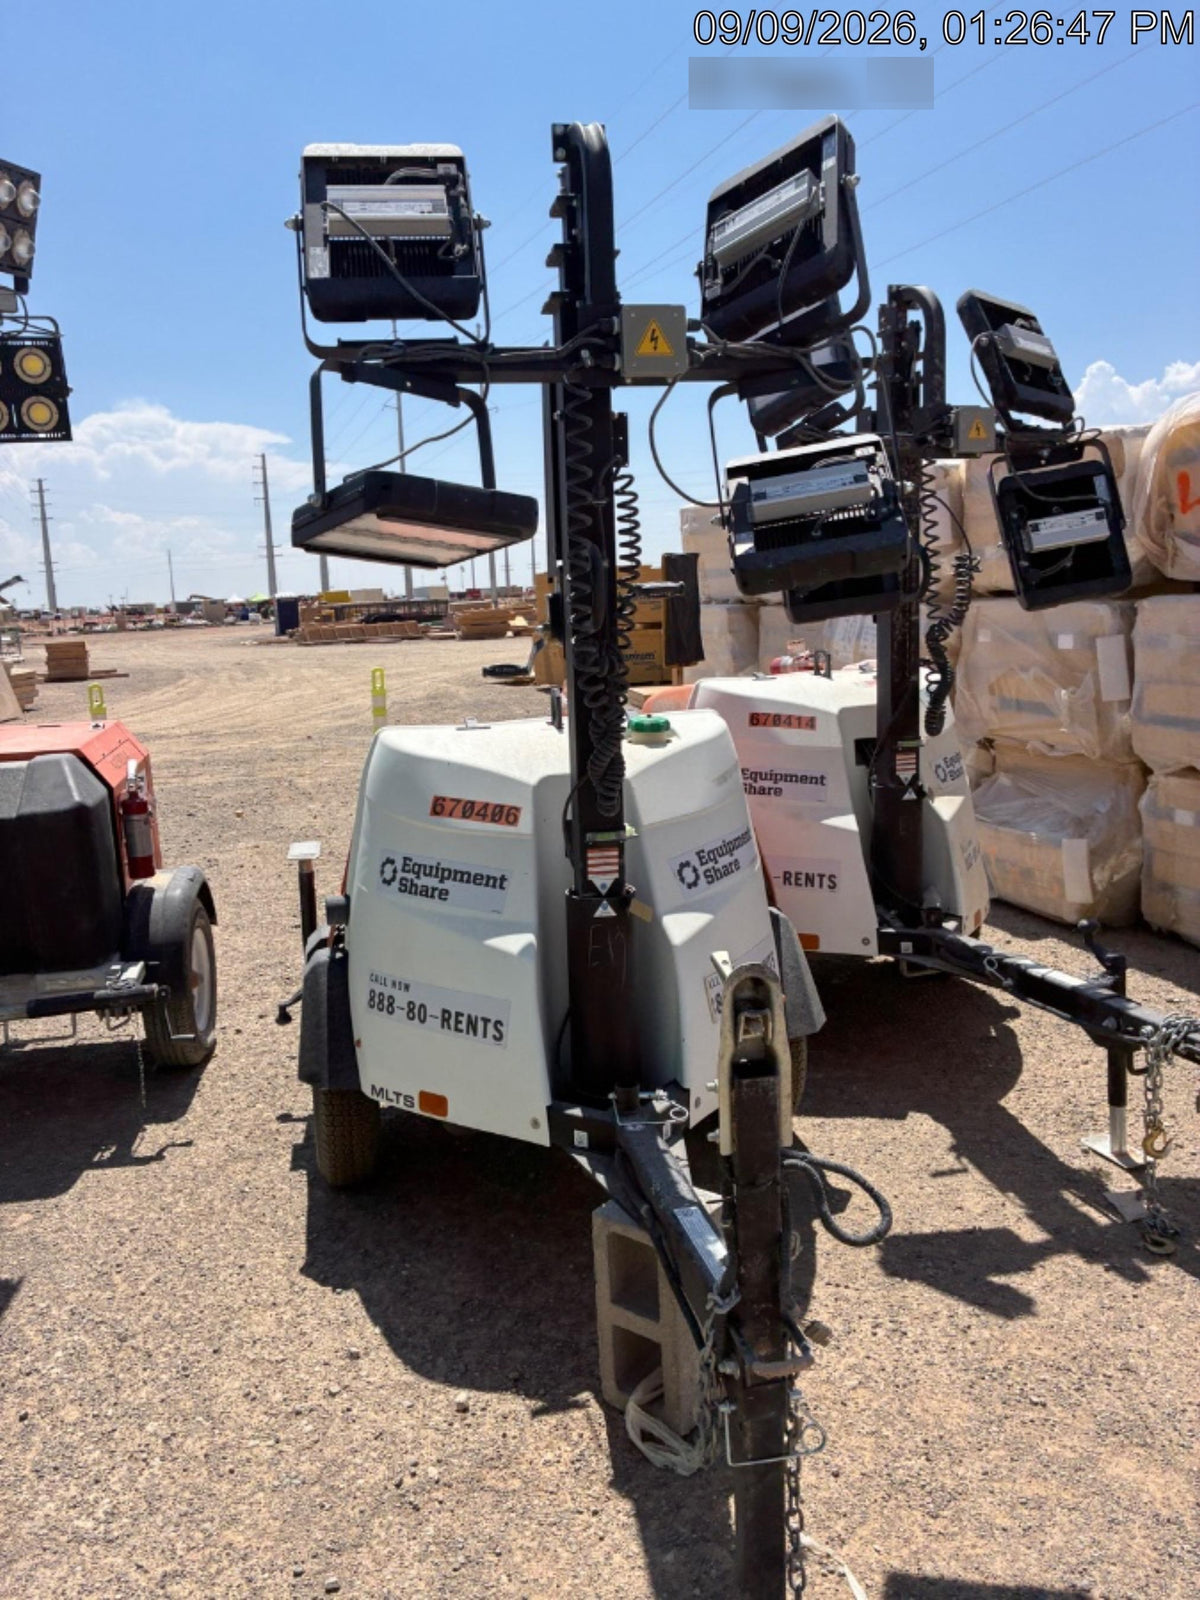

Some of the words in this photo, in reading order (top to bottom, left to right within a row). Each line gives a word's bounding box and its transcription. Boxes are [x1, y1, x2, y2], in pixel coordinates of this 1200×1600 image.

[750, 712, 816, 730] 670414
[432, 796, 520, 825] 670406
[401, 856, 508, 890] Equipment
[703, 858, 740, 885] Share
[398, 877, 449, 901] Share
[368, 988, 504, 1042] 888-80-RENTS
[370, 1084, 415, 1108] MLTS
